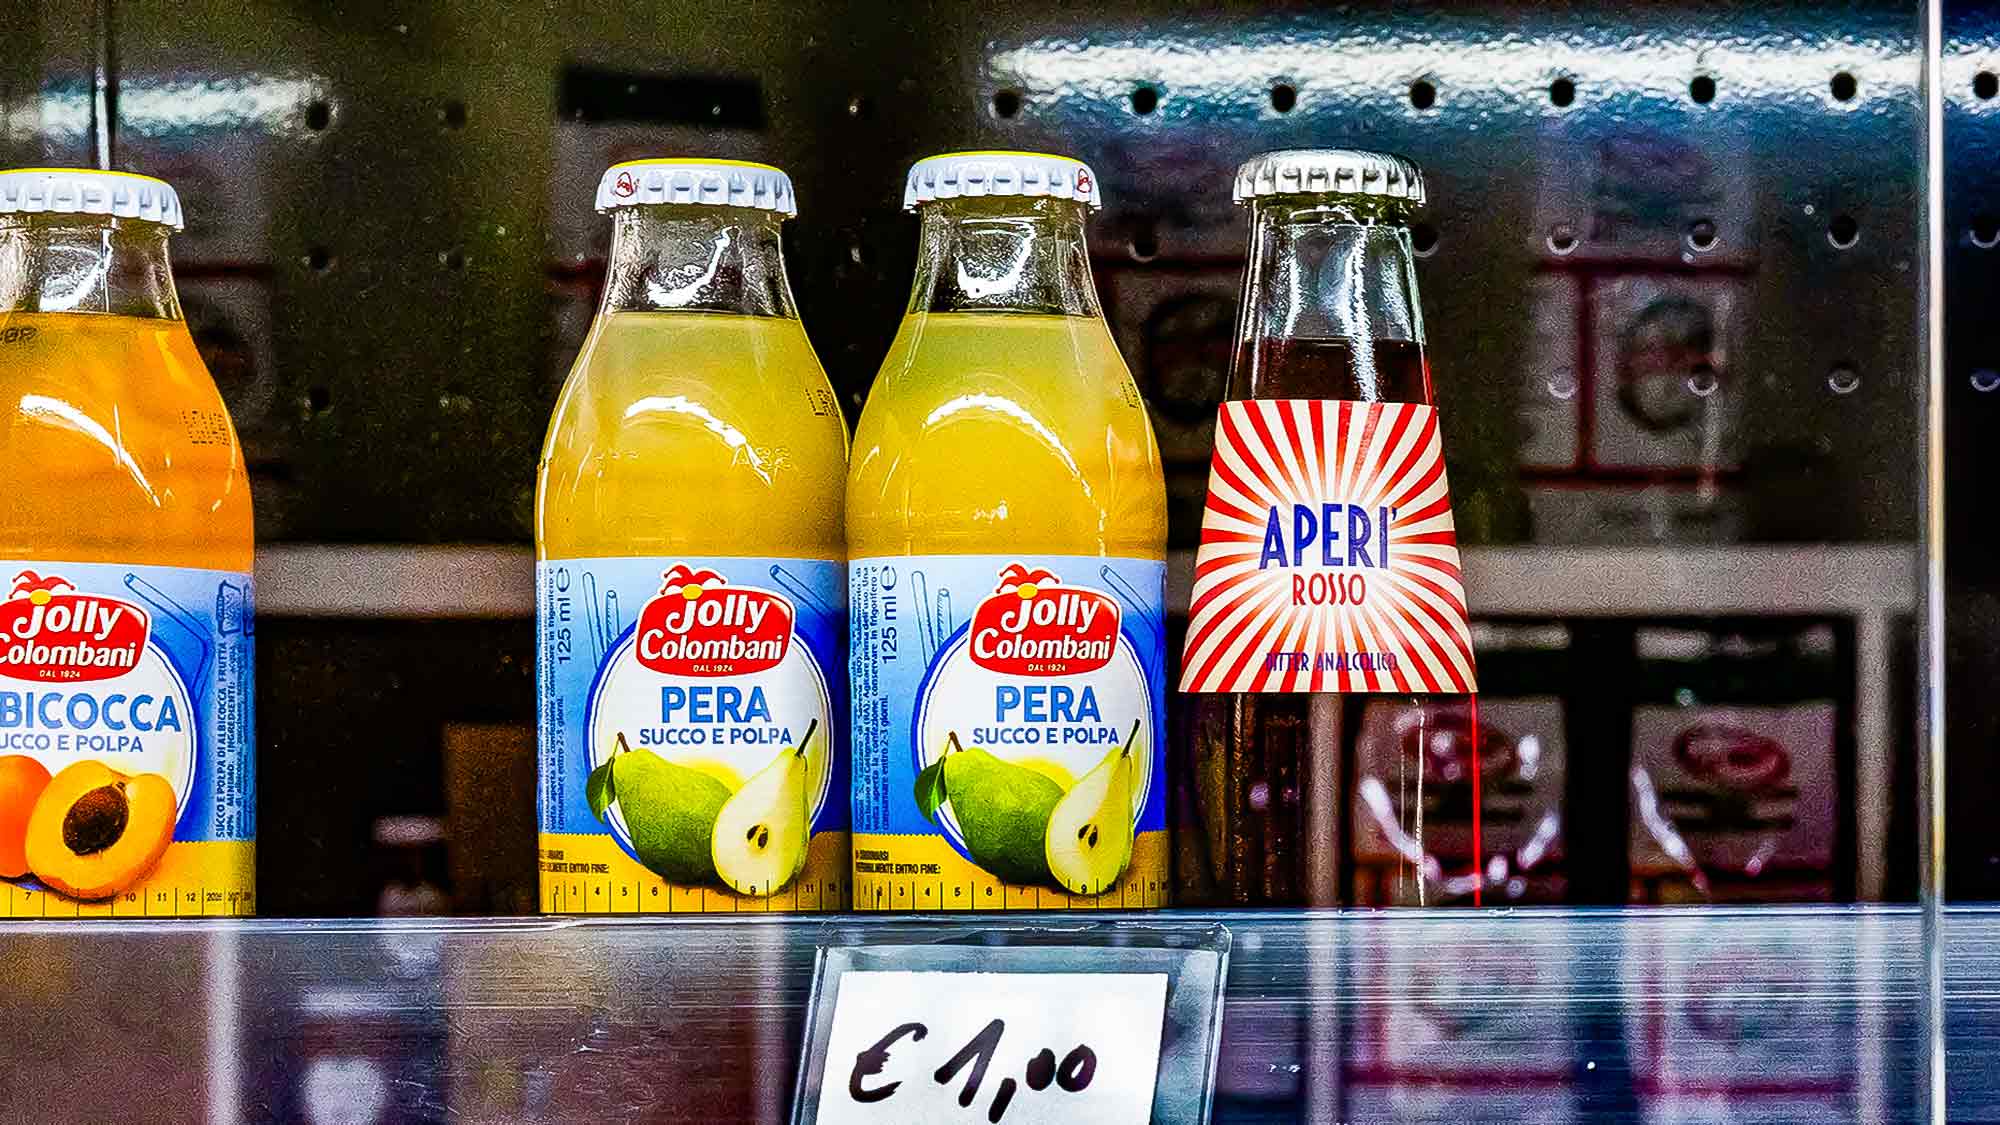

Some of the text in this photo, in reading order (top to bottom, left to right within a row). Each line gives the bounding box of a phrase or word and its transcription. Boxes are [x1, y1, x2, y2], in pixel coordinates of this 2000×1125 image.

[1259, 503, 1397, 570] APERI'
[870, 577, 879, 627] frigorifero
[1292, 573, 1366, 606] ROSSO
[12, 600, 124, 641] Jolly
[556, 597, 571, 621] ml
[666, 594, 770, 634] Jolly
[881, 596, 897, 620] ml
[1001, 593, 1100, 634] Jolly
[556, 627, 571, 664] 125
[640, 629, 782, 661] Colombani
[862, 632, 871, 660] prima
[870, 630, 879, 641] in
[881, 627, 897, 664] 125
[974, 628, 1111, 660] Colombani
[40, 669, 81, 679] DAL 1924
[216, 641, 226, 682] FRUTTA
[692, 664, 733, 673] DAL 1924
[870, 644, 879, 697] conservare
[1027, 664, 1044, 672] DAL
[1266, 651, 1397, 672] BITTER ANALCOLICO
[216, 687, 226, 744] ALBICOCCA
[661, 685, 772, 723] PERA
[995, 685, 1102, 723] PERA
[57, 735, 70, 751] E
[76, 735, 144, 753] POLPA
[216, 746, 226, 758] DI
[640, 728, 792, 745] SUCCO E POLPA
[973, 727, 1119, 745] SUCCO E POLPA
[216, 760, 226, 794] POLPA
[216, 804, 226, 838] SUCCO
[25, 892, 31, 900] 7
[157, 893, 167, 902] 11
[185, 892, 196, 901] 12
[621, 886, 628, 897] 5
[651, 886, 658, 897] 6
[954, 886, 961, 897] 5
[985, 886, 993, 897] 6
[849, 1021, 929, 1103] €
